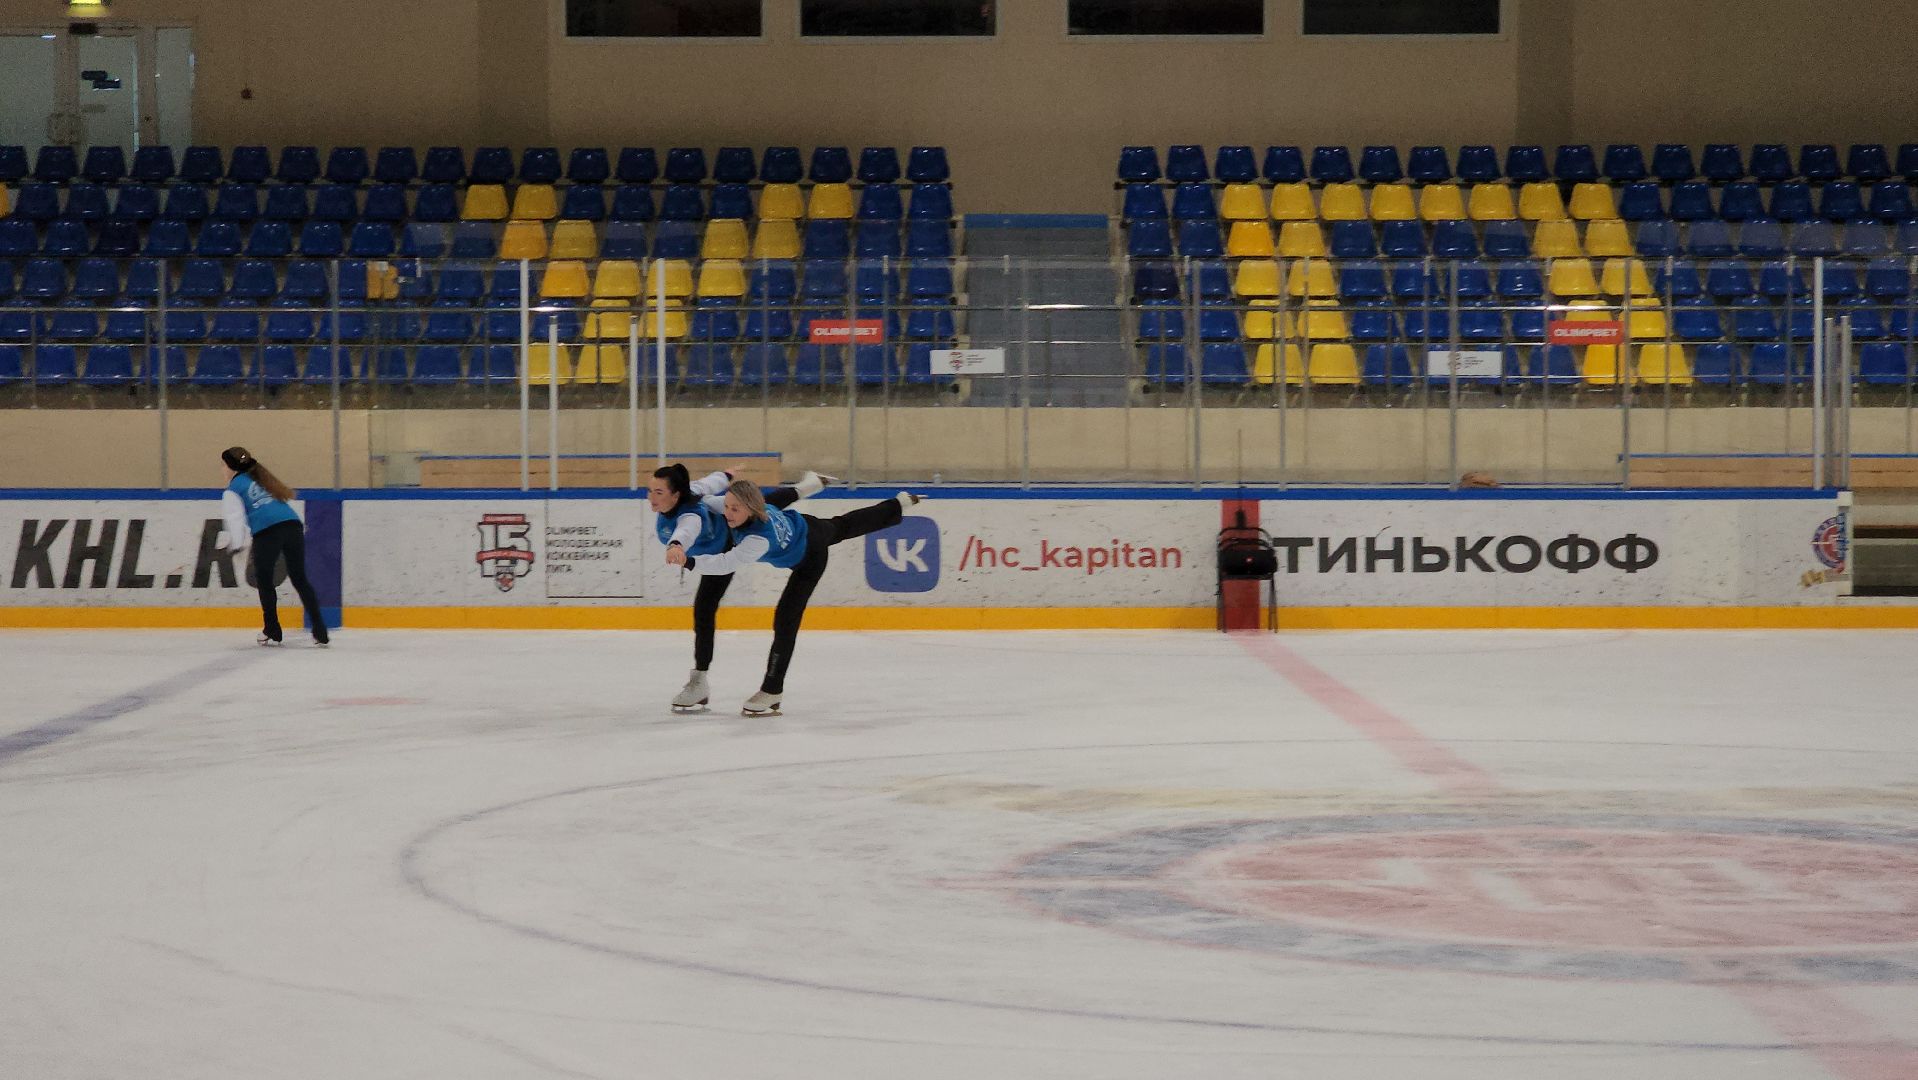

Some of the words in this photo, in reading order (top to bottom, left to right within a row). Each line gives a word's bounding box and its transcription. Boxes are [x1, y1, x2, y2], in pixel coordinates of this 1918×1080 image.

[1554, 328, 1618, 337] OLIMPBET
[876, 538, 929, 573] VK
[959, 535, 1182, 575] /hc_kapitan
[1272, 533, 1659, 574] ТИНЬКОФФ
